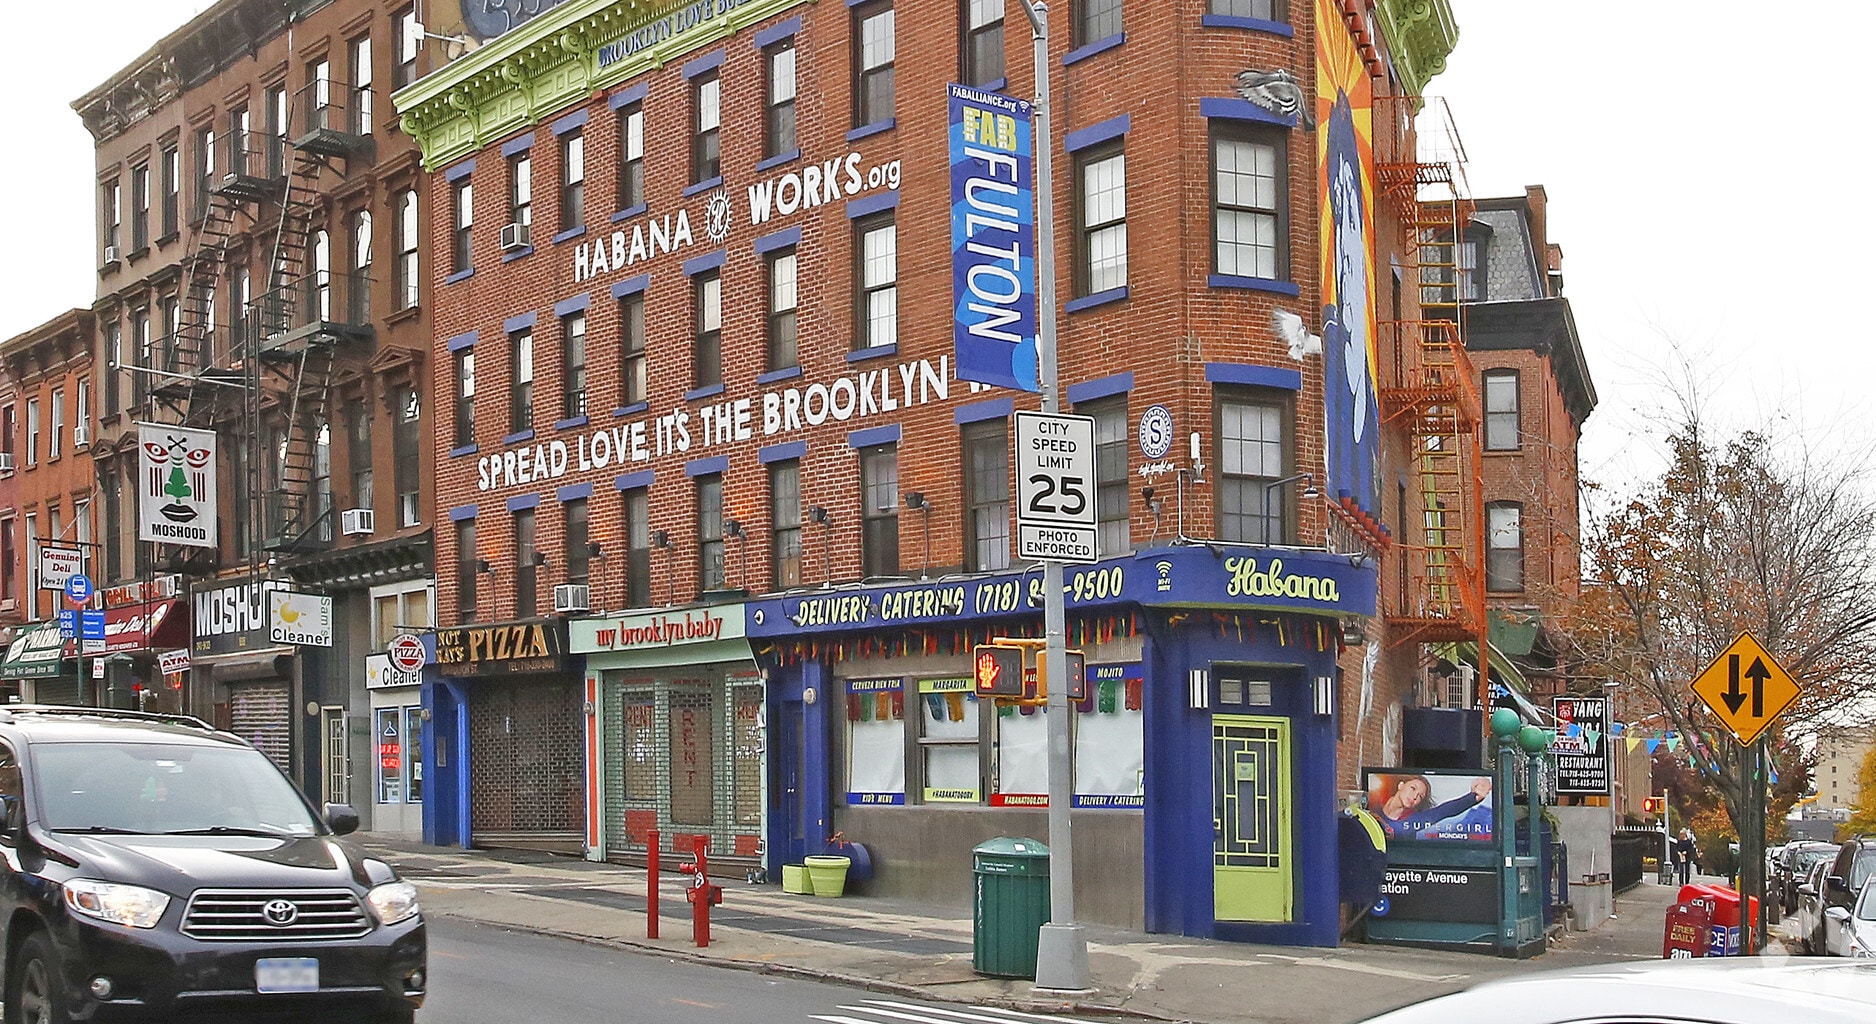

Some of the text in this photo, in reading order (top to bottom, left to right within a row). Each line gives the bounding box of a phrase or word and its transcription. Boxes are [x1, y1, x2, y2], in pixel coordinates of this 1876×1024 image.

[598, 16, 672, 68] BROOKLYN
[952, 86, 1016, 113] FABALLIANCE.org
[963, 106, 1017, 152] FAB
[574, 208, 694, 283] HABANA
[748, 151, 901, 226] WORKS.org
[964, 146, 1022, 343] FULTON
[477, 354, 948, 491] SPREAD LOVE, IT'S THE BROOKLYN
[1038, 422, 1070, 435] CITY
[1150, 418, 1162, 445] S
[1032, 438, 1077, 453] SPEED
[1037, 455, 1073, 469] LIMIT
[1029, 474, 1086, 515] 25
[152, 523, 206, 540] MOSHOOD
[1038, 530, 1078, 543] PHOTO
[43, 550, 80, 562] Genuine
[1027, 542, 1090, 556] ENFORCED
[52, 563, 71, 573] Deli
[1225, 557, 1340, 602] Habana
[799, 566, 1123, 627] DELIVERY CATERING (718) 8-9500
[196, 579, 290, 637] MOSHO
[321, 596, 331, 637] Sam's
[272, 628, 330, 645] Cleaner
[596, 610, 723, 650] my brooklyn baby
[438, 630, 461, 647] NOT
[469, 624, 549, 661] PIZZA
[394, 647, 424, 658] PIZZA
[162, 656, 190, 667] ATM
[1097, 667, 1123, 678] MOJITO
[1573, 702, 1602, 718] YANG
[1552, 741, 1580, 750] ATM
[1560, 757, 1603, 769] RESTAURANT
[1079, 795, 1107, 805] DELIVERY
[1114, 796, 1144, 806] CATERING
[1403, 821, 1492, 833] SUPERGIRL
[1385, 871, 1468, 884] ayette Avenue
[1381, 883, 1409, 894] ation
[1673, 924, 1695, 935] FREE
[1671, 933, 1696, 943] DAILY
[1671, 948, 1692, 960] am
